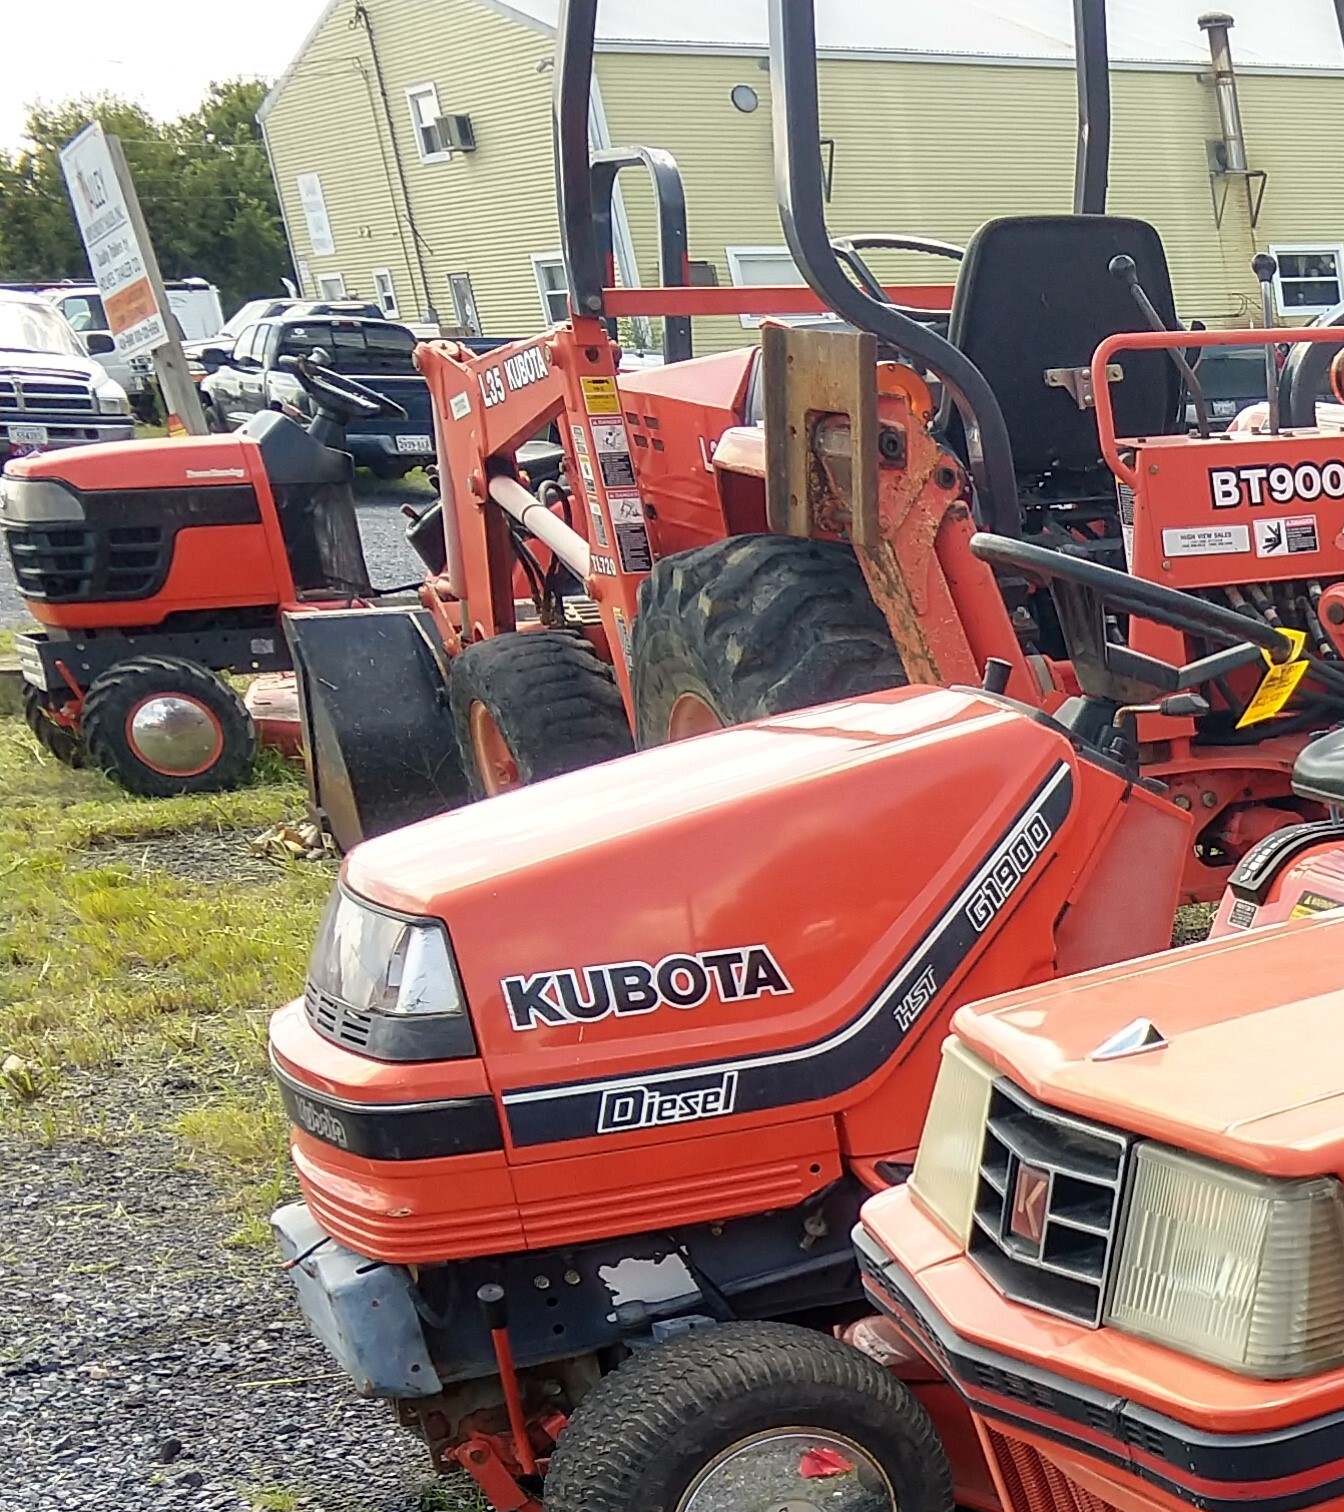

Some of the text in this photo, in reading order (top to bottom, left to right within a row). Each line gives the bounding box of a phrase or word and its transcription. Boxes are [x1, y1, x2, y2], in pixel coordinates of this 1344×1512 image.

[477, 365, 506, 409] L35
[504, 345, 549, 392] KUBOTA
[964, 812, 1052, 932] G1900
[499, 944, 795, 1032] KUBOTA
[892, 963, 938, 1032] HST
[596, 1069, 739, 1134] Diesel
[1017, 1172, 1048, 1239] K
